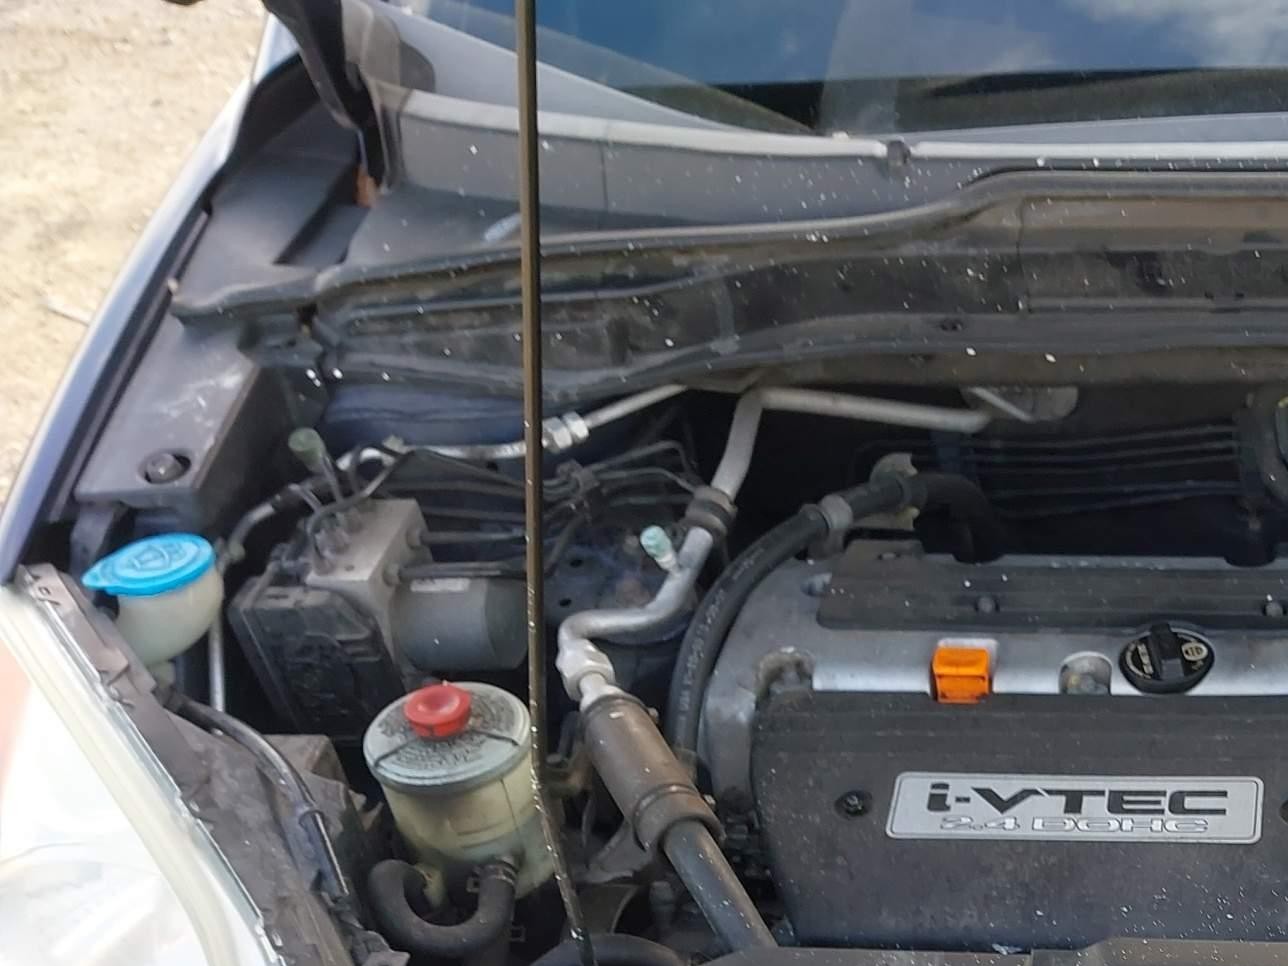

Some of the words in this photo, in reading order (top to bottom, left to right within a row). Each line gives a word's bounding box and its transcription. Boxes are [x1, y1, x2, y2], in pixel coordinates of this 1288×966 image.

[926, 781, 1229, 816] i-VTEC
[939, 815, 1021, 832] 2.4
[1030, 816, 1210, 834] DOHC
